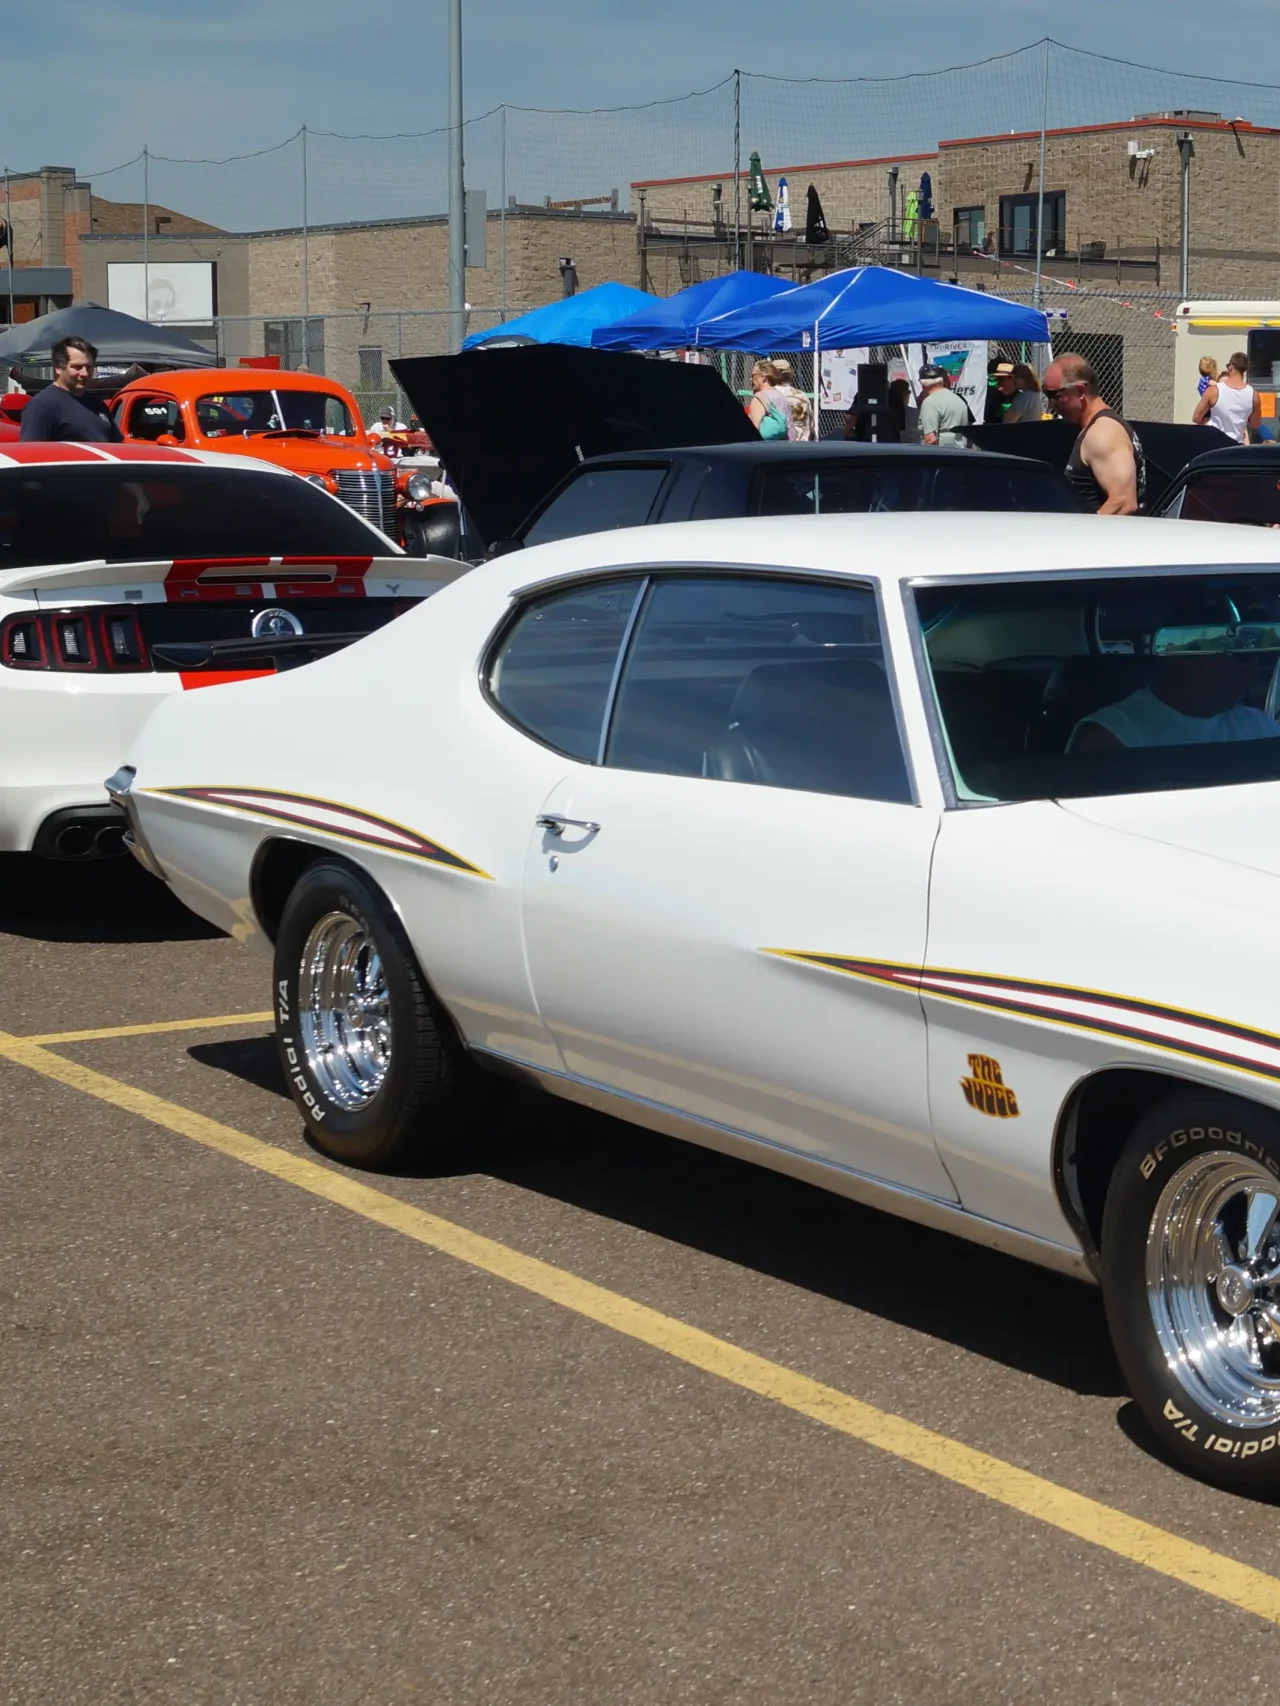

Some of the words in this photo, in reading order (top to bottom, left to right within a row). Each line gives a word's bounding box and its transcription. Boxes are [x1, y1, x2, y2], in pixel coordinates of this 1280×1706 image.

[278, 979, 289, 1025] T/A
[283, 1037, 326, 1122] Radial
[967, 1053, 1003, 1084] THE
[958, 1076, 1021, 1119] JUDGE
[1163, 1398, 1199, 1442] T/A
